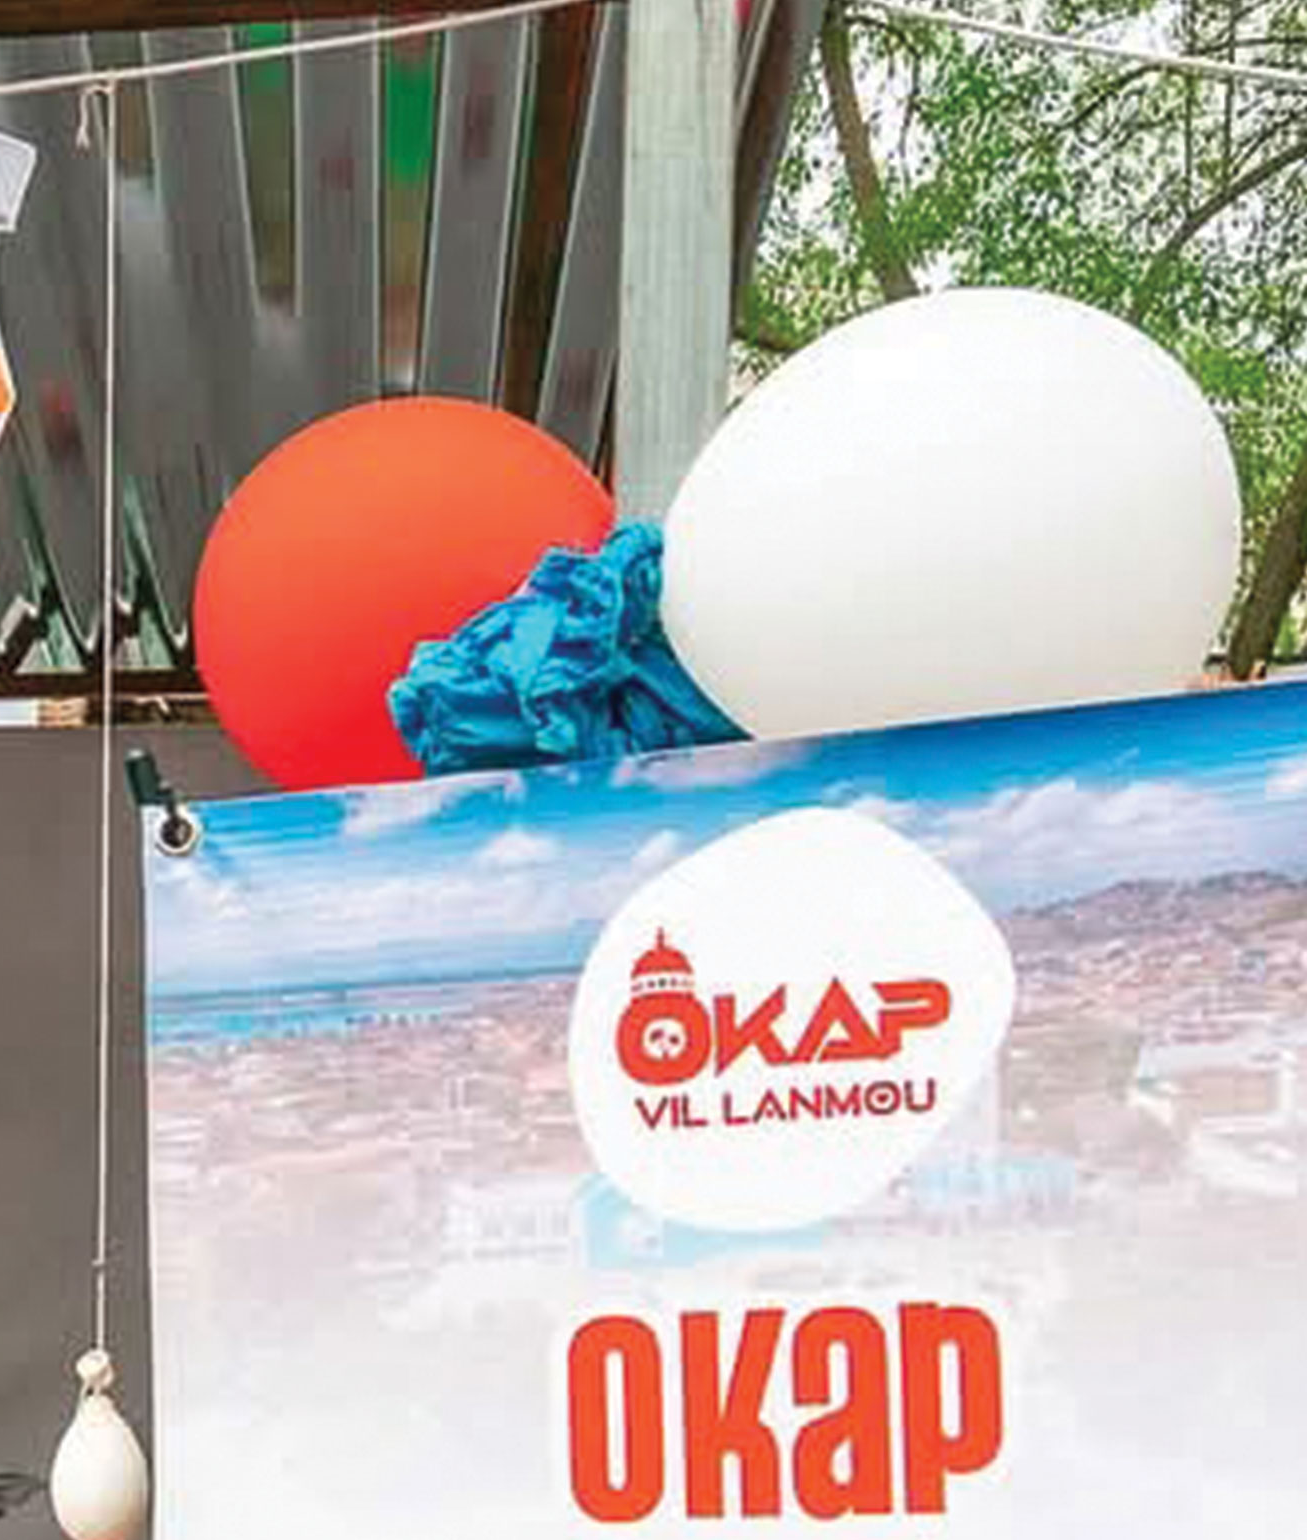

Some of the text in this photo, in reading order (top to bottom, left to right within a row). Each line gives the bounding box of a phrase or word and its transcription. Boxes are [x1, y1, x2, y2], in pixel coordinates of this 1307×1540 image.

[616, 977, 951, 1086] OKAP
[635, 1079, 937, 1129] VIL LANMOU
